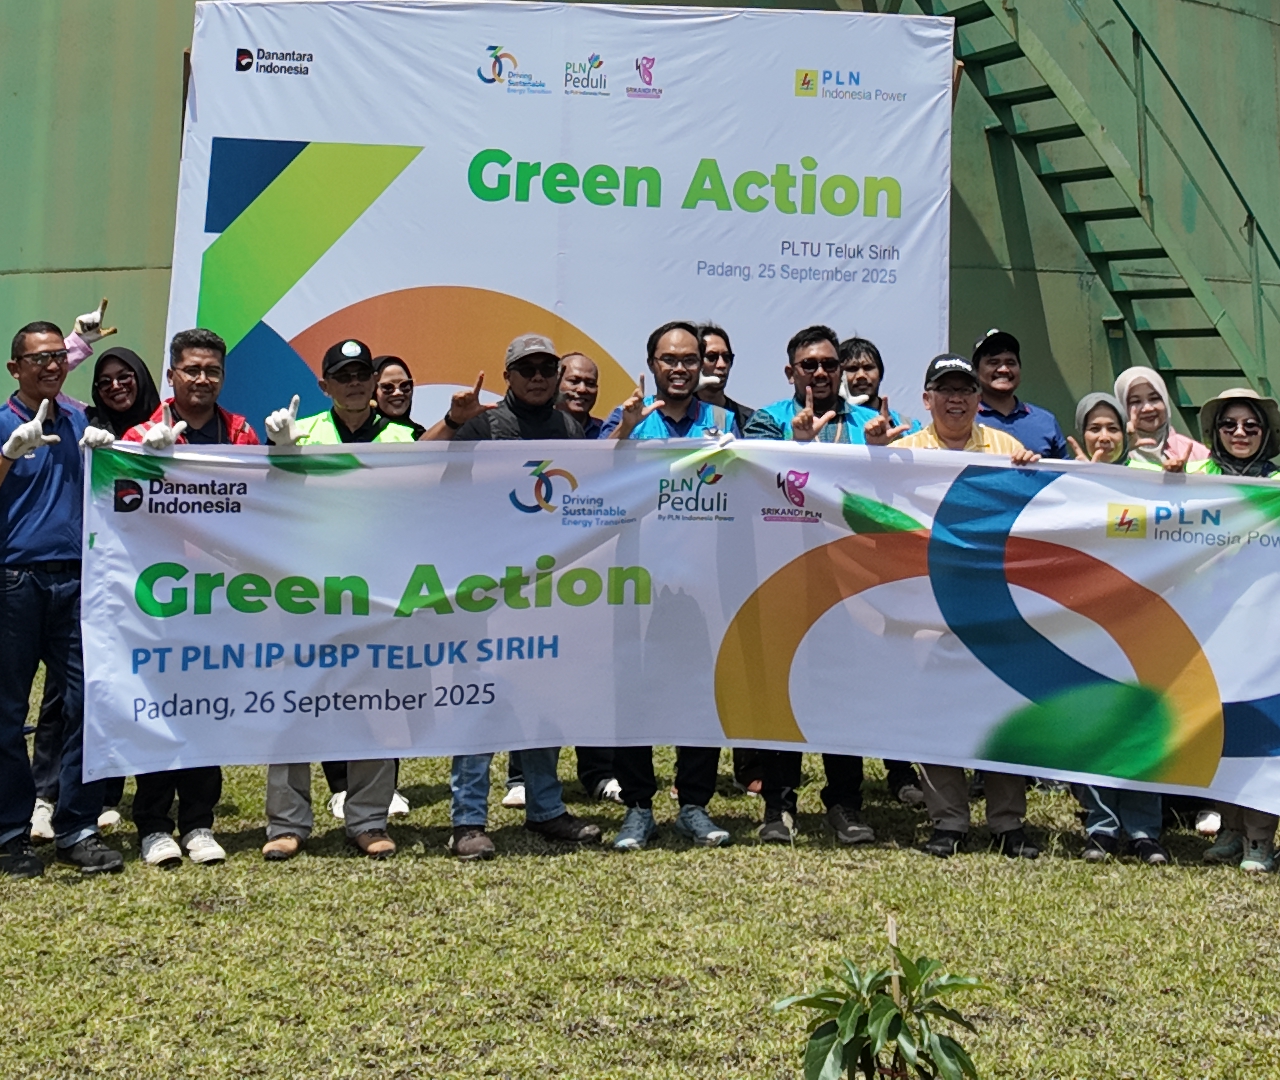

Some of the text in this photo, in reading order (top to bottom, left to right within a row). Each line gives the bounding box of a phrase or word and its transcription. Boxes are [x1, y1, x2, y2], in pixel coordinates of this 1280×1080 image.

[256, 48, 314, 62] Danantara
[256, 61, 309, 75] Indonesia
[565, 62, 587, 74] PLN
[564, 73, 607, 89] Peduli
[822, 70, 860, 86] PLN
[821, 87, 907, 101] Indonesia Power
[468, 148, 902, 218] Green Action
[781, 241, 900, 260] PLTU Teluk Sirih
[758, 263, 776, 279] 25
[780, 264, 857, 283] September
[861, 268, 897, 284] 2025
[148, 478, 247, 495] Danantara
[659, 477, 693, 493] PLN
[148, 497, 241, 514] Indonesia
[562, 494, 604, 507] Driving
[657, 492, 728, 512] Peduli
[562, 506, 627, 516] Sustainable
[804, 510, 822, 519] PLN
[1154, 506, 1221, 526] PLN
[562, 517, 594, 528] Energy
[1154, 527, 1241, 547] Indonesia
[134, 555, 652, 618] Green Action
[132, 635, 559, 674] PT PLN IP UBP TELUK SIRIH
[134, 683, 496, 721] Padang, 26 September 2025
